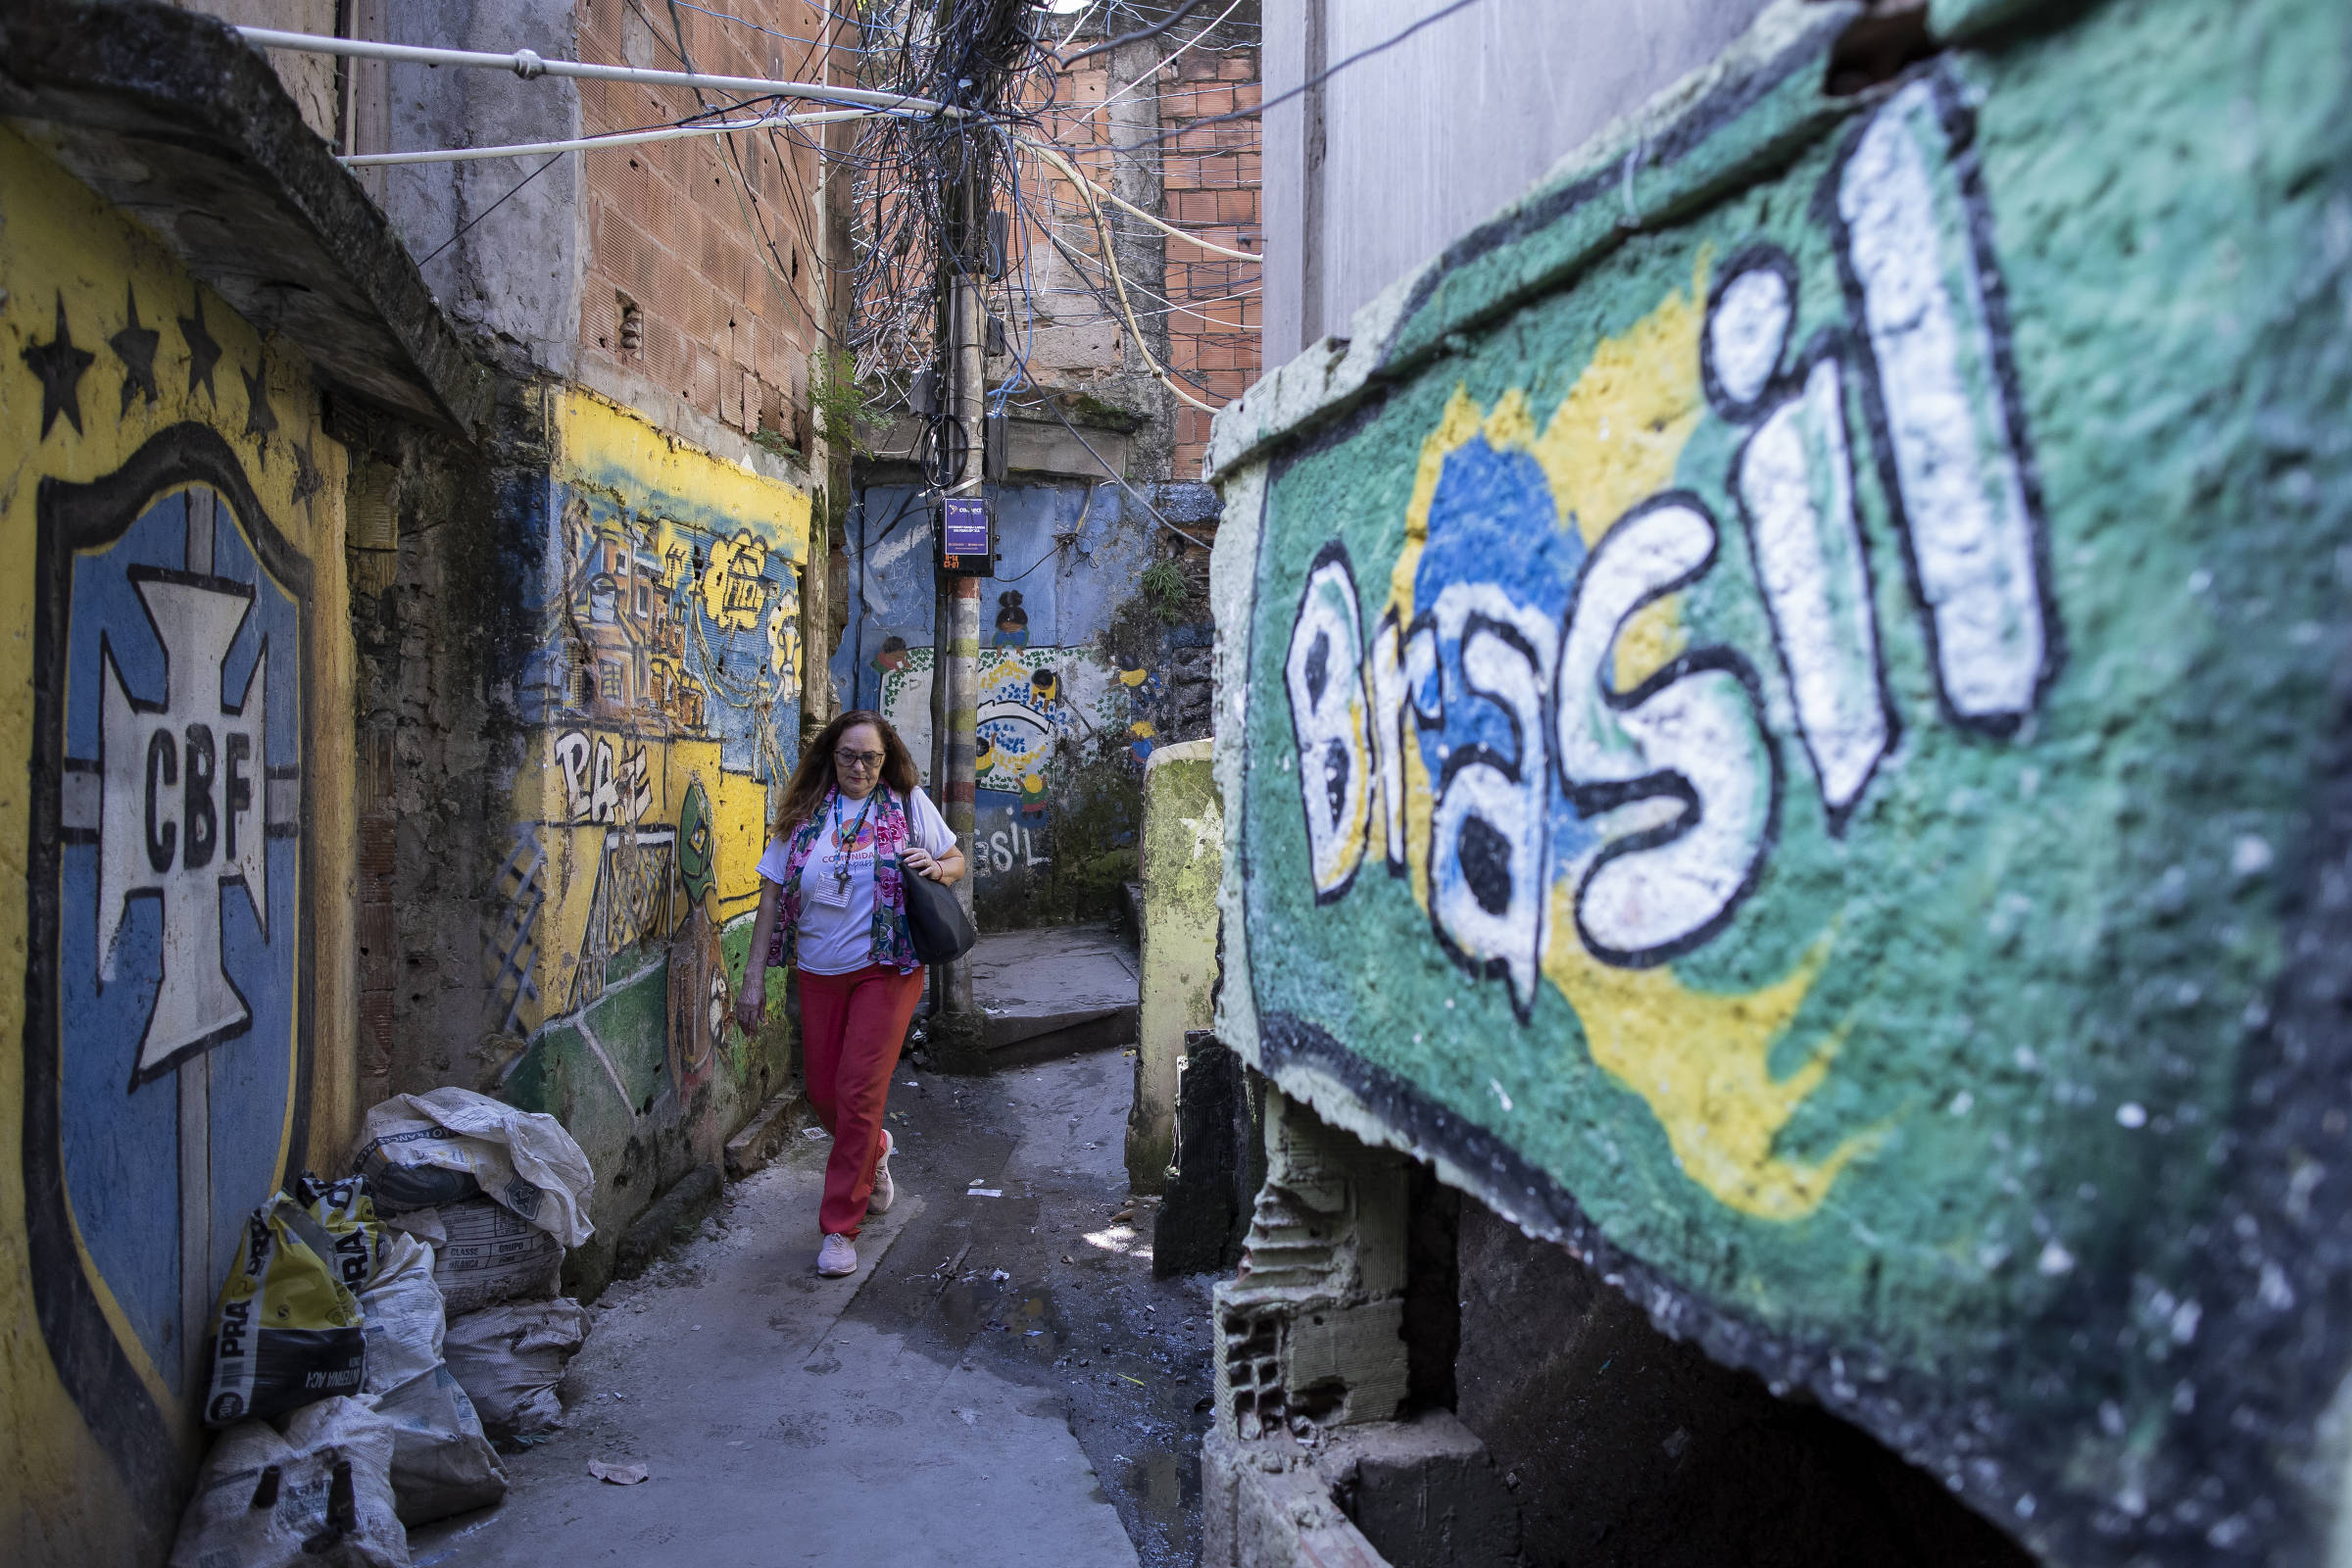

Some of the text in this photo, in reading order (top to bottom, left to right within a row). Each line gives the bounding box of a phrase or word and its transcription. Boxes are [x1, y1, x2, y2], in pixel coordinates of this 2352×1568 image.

[1284, 65, 2066, 1025] Brasil
[144, 722, 252, 874] CBF
[499, 1242, 524, 1253] GRUPO
